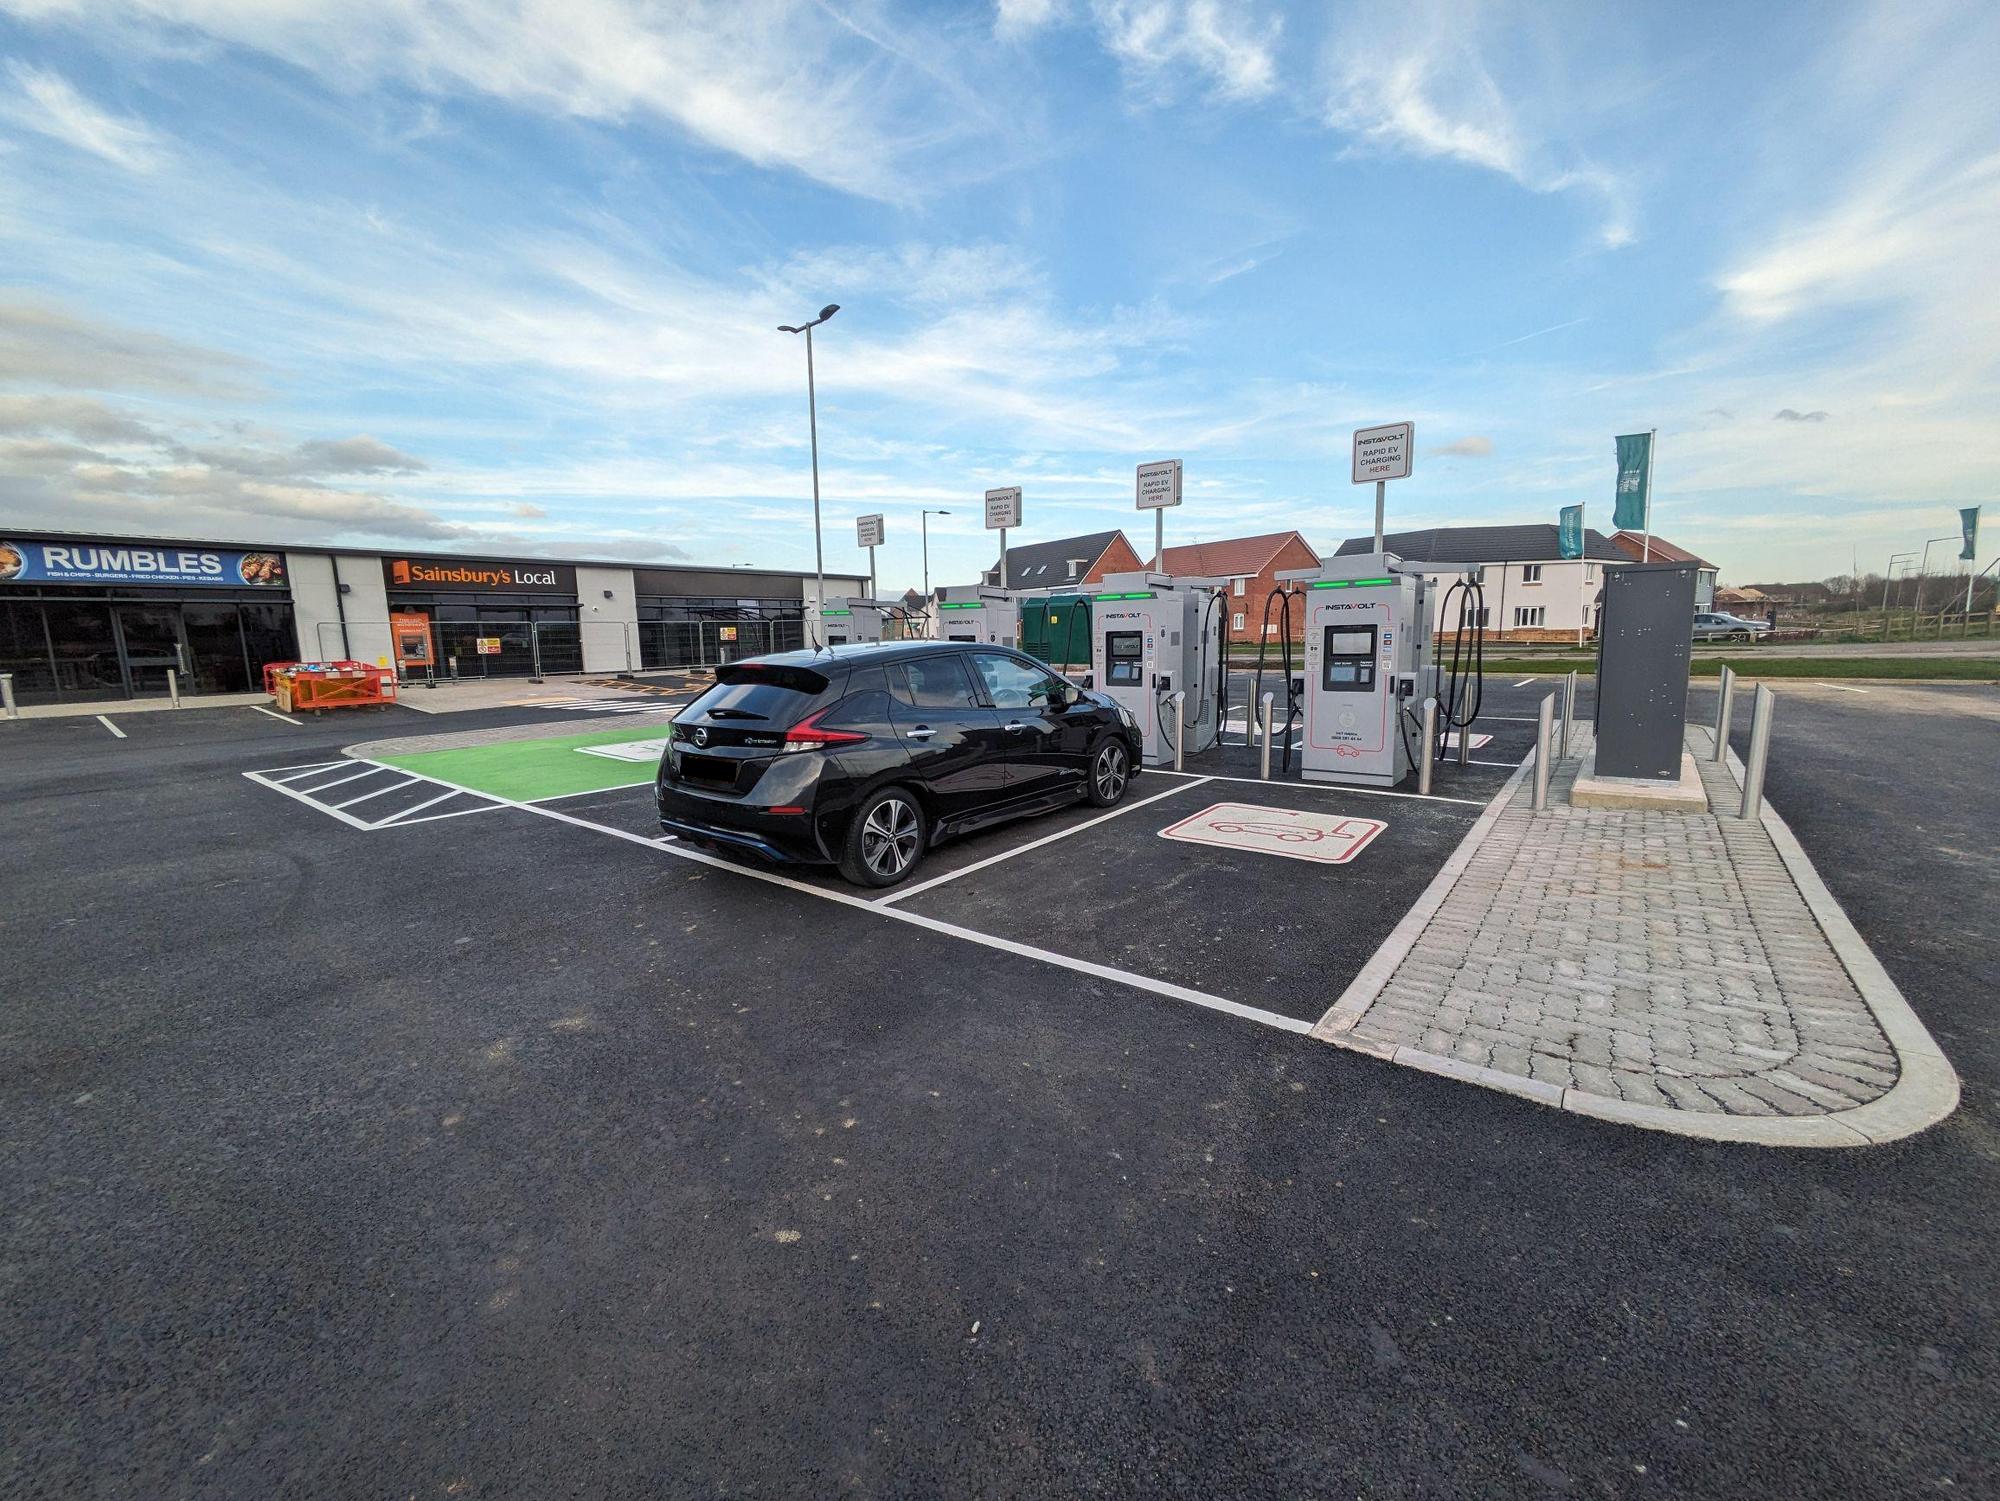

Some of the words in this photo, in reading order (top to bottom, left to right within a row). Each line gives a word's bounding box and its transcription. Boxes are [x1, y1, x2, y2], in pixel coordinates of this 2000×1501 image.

[1358, 433, 1404, 445] INSTAVOLT
[1363, 448, 1386, 457] RAPID
[1360, 454, 1401, 466] CHARGING
[1369, 465, 1391, 473] HERE
[1141, 486, 1170, 495] CHARGING
[43, 547, 222, 574] RUMBLES
[411, 566, 511, 586] Sainsbury's
[515, 569, 556, 585] Local
[1325, 602, 1376, 611] INSTAVOLT
